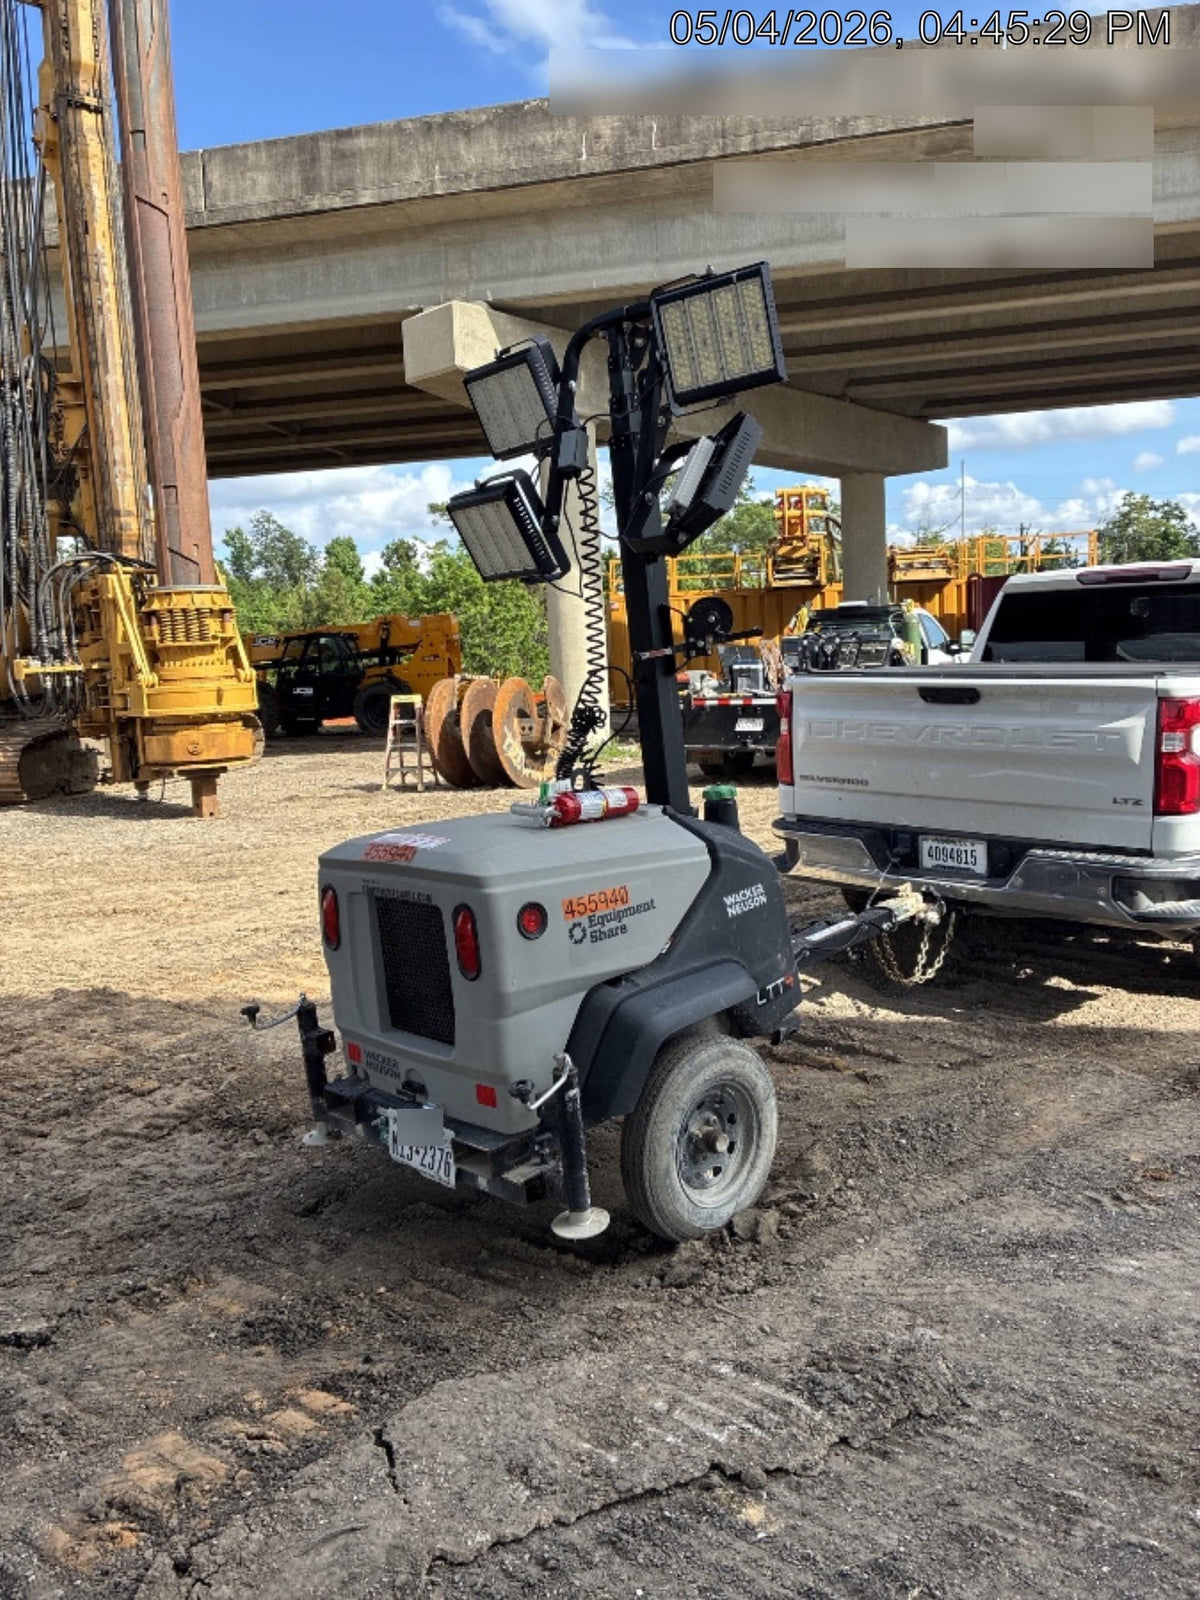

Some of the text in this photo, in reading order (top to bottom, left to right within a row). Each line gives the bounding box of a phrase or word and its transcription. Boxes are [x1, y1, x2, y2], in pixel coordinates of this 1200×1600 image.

[807, 718, 1122, 751] CHEVROLET
[798, 774, 870, 786] SILVERADO
[1112, 796, 1145, 807] LTZ
[564, 885, 630, 918] 455940
[723, 883, 766, 906] WACKER
[726, 893, 767, 918] NEUSON
[588, 897, 657, 929] Equipment
[589, 923, 628, 943] Share
[364, 1048, 399, 1070] WACKER
